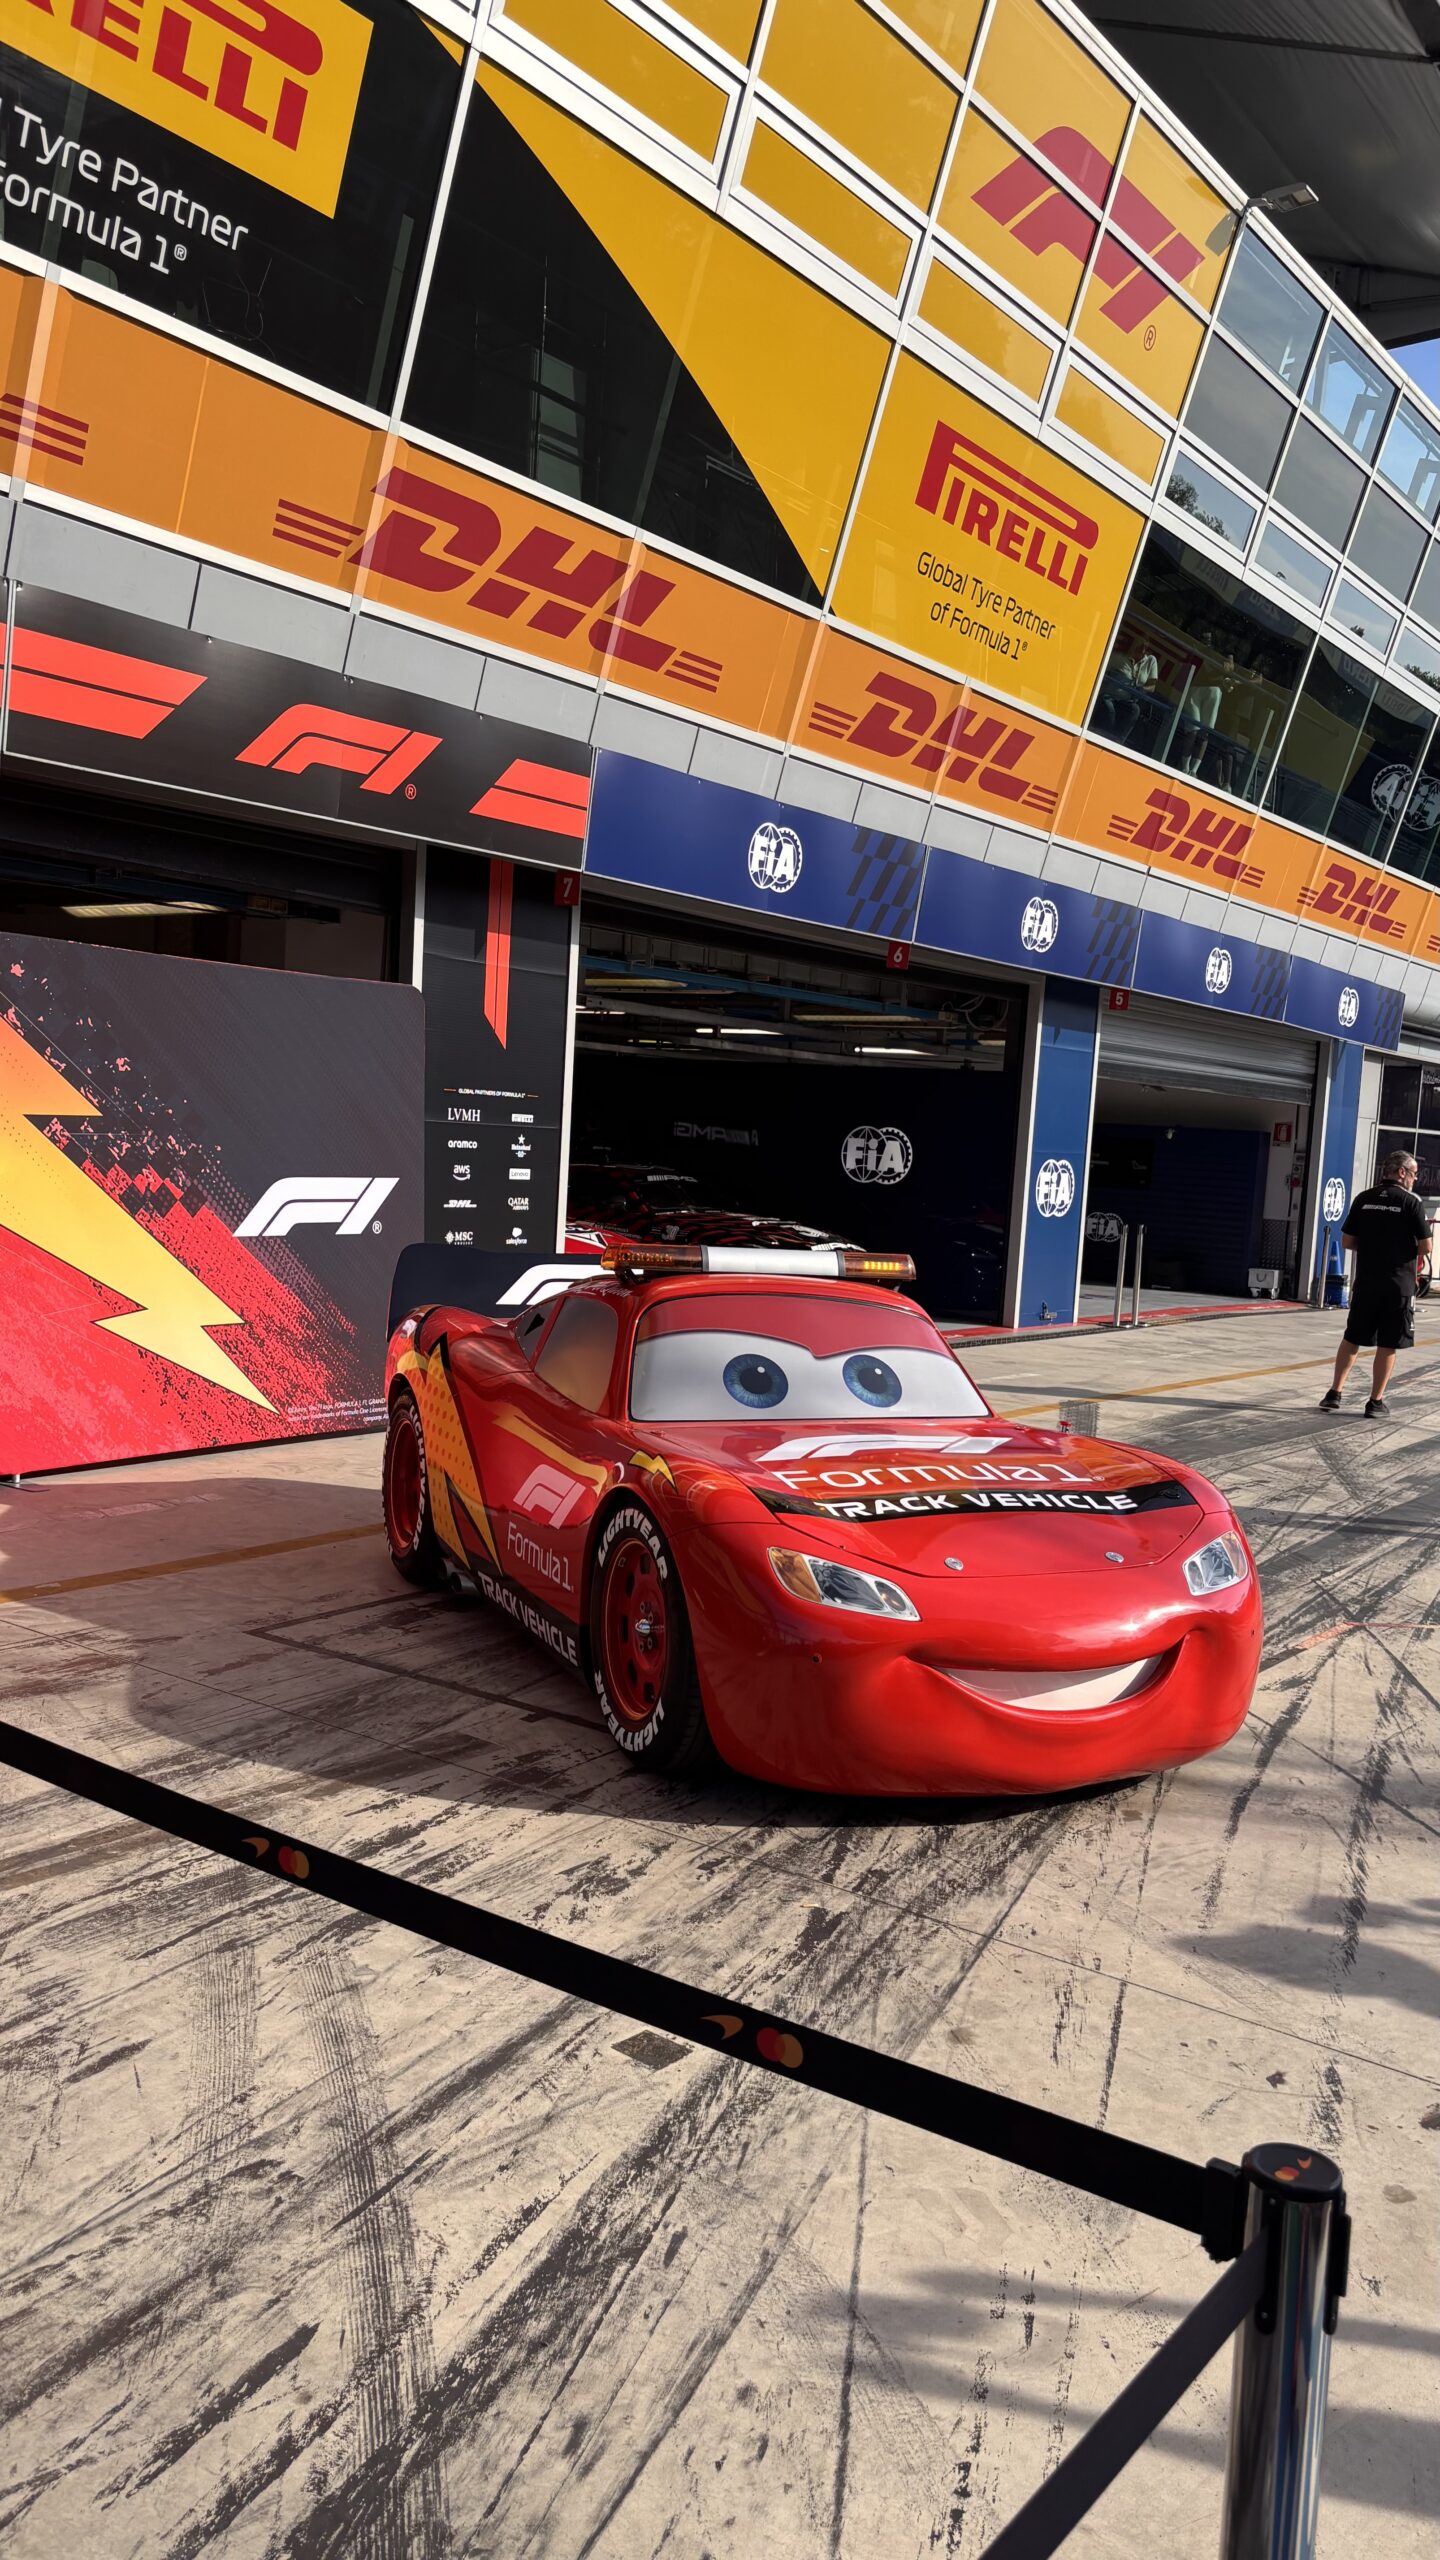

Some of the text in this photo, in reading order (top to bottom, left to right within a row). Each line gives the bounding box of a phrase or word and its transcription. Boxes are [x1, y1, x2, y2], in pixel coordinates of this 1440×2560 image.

[14, 105, 249, 250] Tyre Partner
[915, 420, 1099, 596] PIRELLI
[346, 466, 676, 672] DHL
[917, 551, 1056, 640] Global Tyre Partner
[930, 602, 951, 625] of
[950, 608, 1010, 655] Formula
[846, 672, 1035, 802] DHL
[1129, 789, 1255, 881] DHL
[563, 877, 574, 898] 7
[1312, 863, 1400, 934] DHL
[894, 946, 903, 963] 6
[1115, 992, 1124, 1006] 5
[448, 1107, 481, 1122] LVMH
[448, 1139, 478, 1149] aramco
[453, 1164, 471, 1174] aws
[508, 1197, 529, 1207] QATAR
[511, 1170, 529, 1178] Lenovo
[232, 1176, 400, 1237] F1
[448, 1199, 475, 1208] DHL
[454, 1231, 474, 1241] MSC
[513, 1464, 586, 1530] F1
[814, 1492, 1138, 1519] TRACK VEHICLE
[597, 1508, 668, 1581] LIGHTYEAR
[478, 1570, 579, 1667] TRACK VEHICLE
[594, 1669, 665, 1752] LIGHTYEAR
